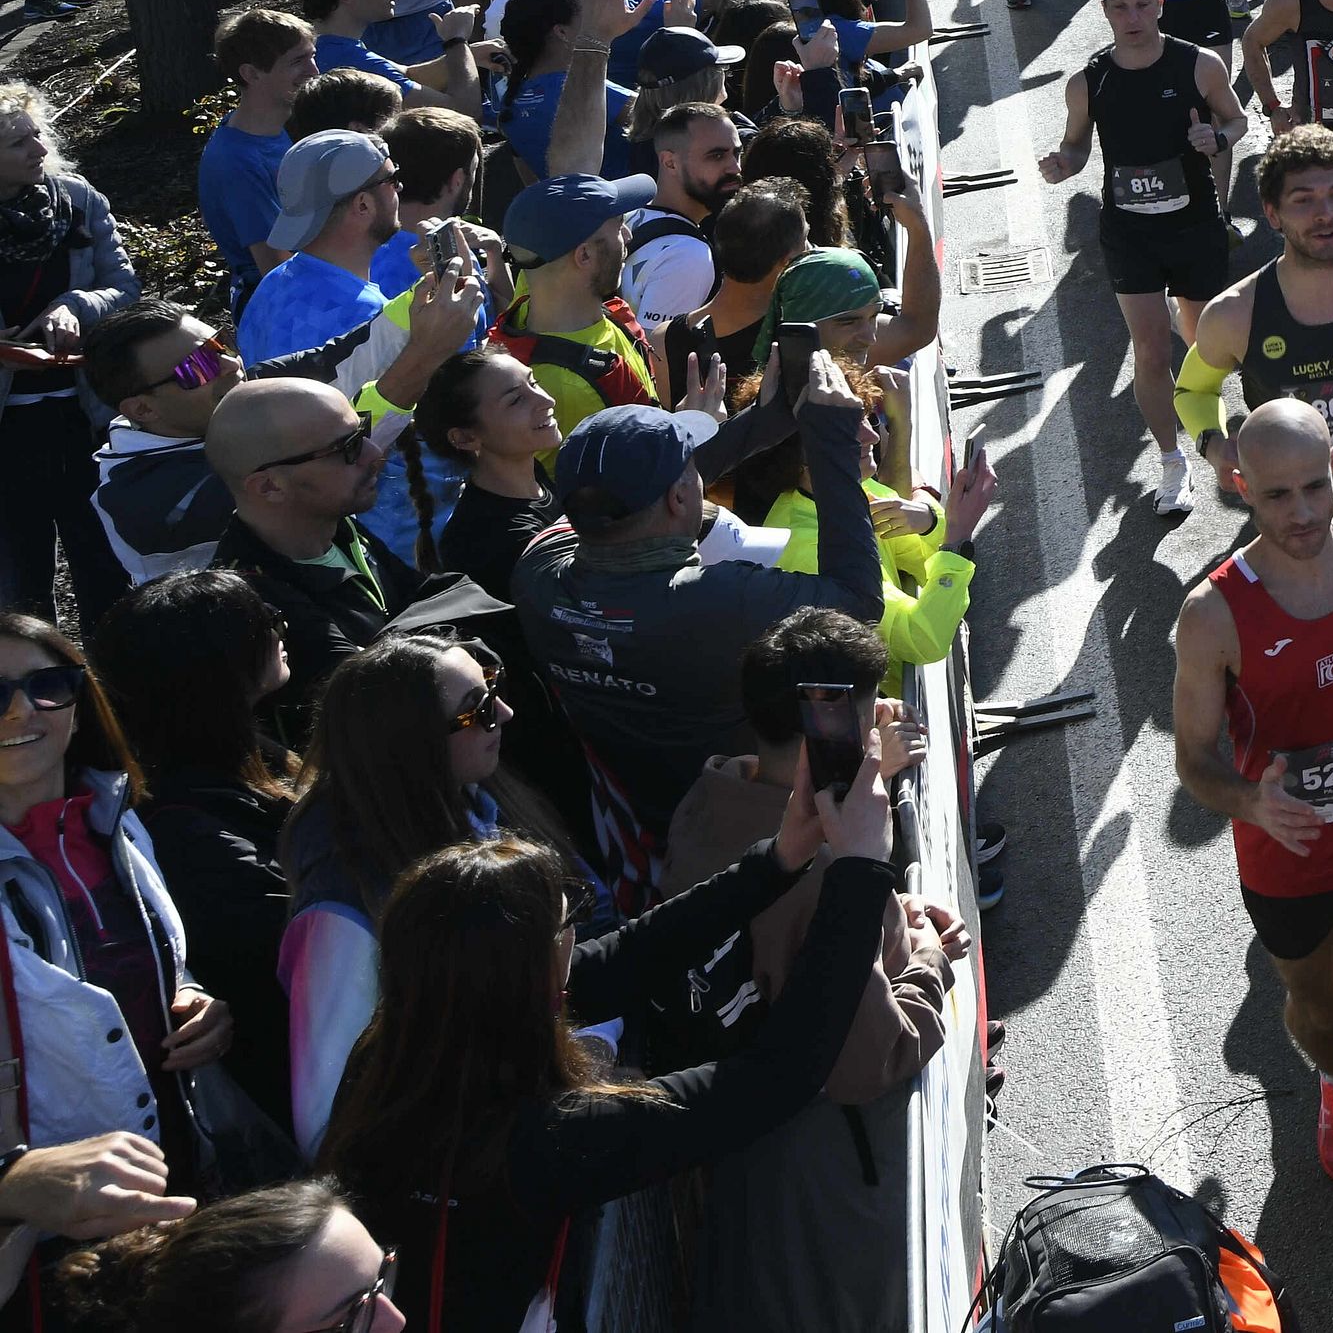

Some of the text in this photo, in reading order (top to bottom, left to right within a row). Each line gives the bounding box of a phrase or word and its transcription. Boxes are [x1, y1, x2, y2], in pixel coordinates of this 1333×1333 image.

[1114, 169, 1121, 179] A
[1130, 176, 1165, 194] 814
[643, 311, 660, 322] NO
[1292, 361, 1331, 377] LUCKY
[550, 663, 657, 697] RENATO
